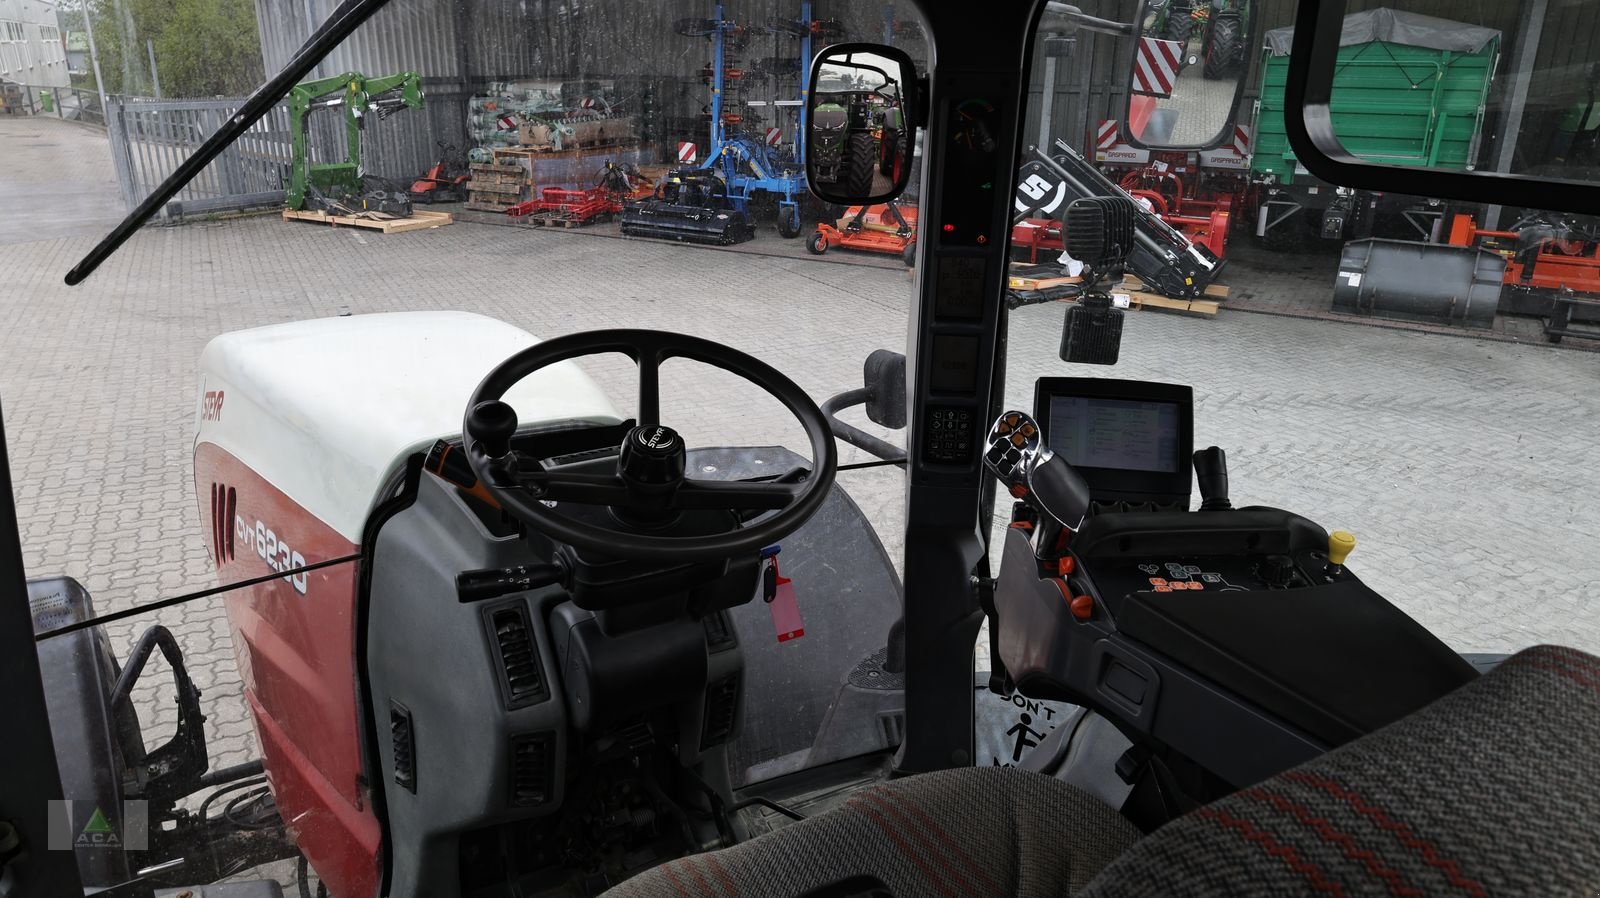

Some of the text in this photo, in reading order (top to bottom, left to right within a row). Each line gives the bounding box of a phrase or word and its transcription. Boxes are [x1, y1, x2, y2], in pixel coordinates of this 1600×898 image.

[1107, 151, 1137, 160] GASPARDO
[1210, 156, 1241, 165] GASPARDO
[202, 390, 225, 422] STEYR
[647, 427, 665, 449] STEYR
[236, 515, 307, 595] CVT 6230
